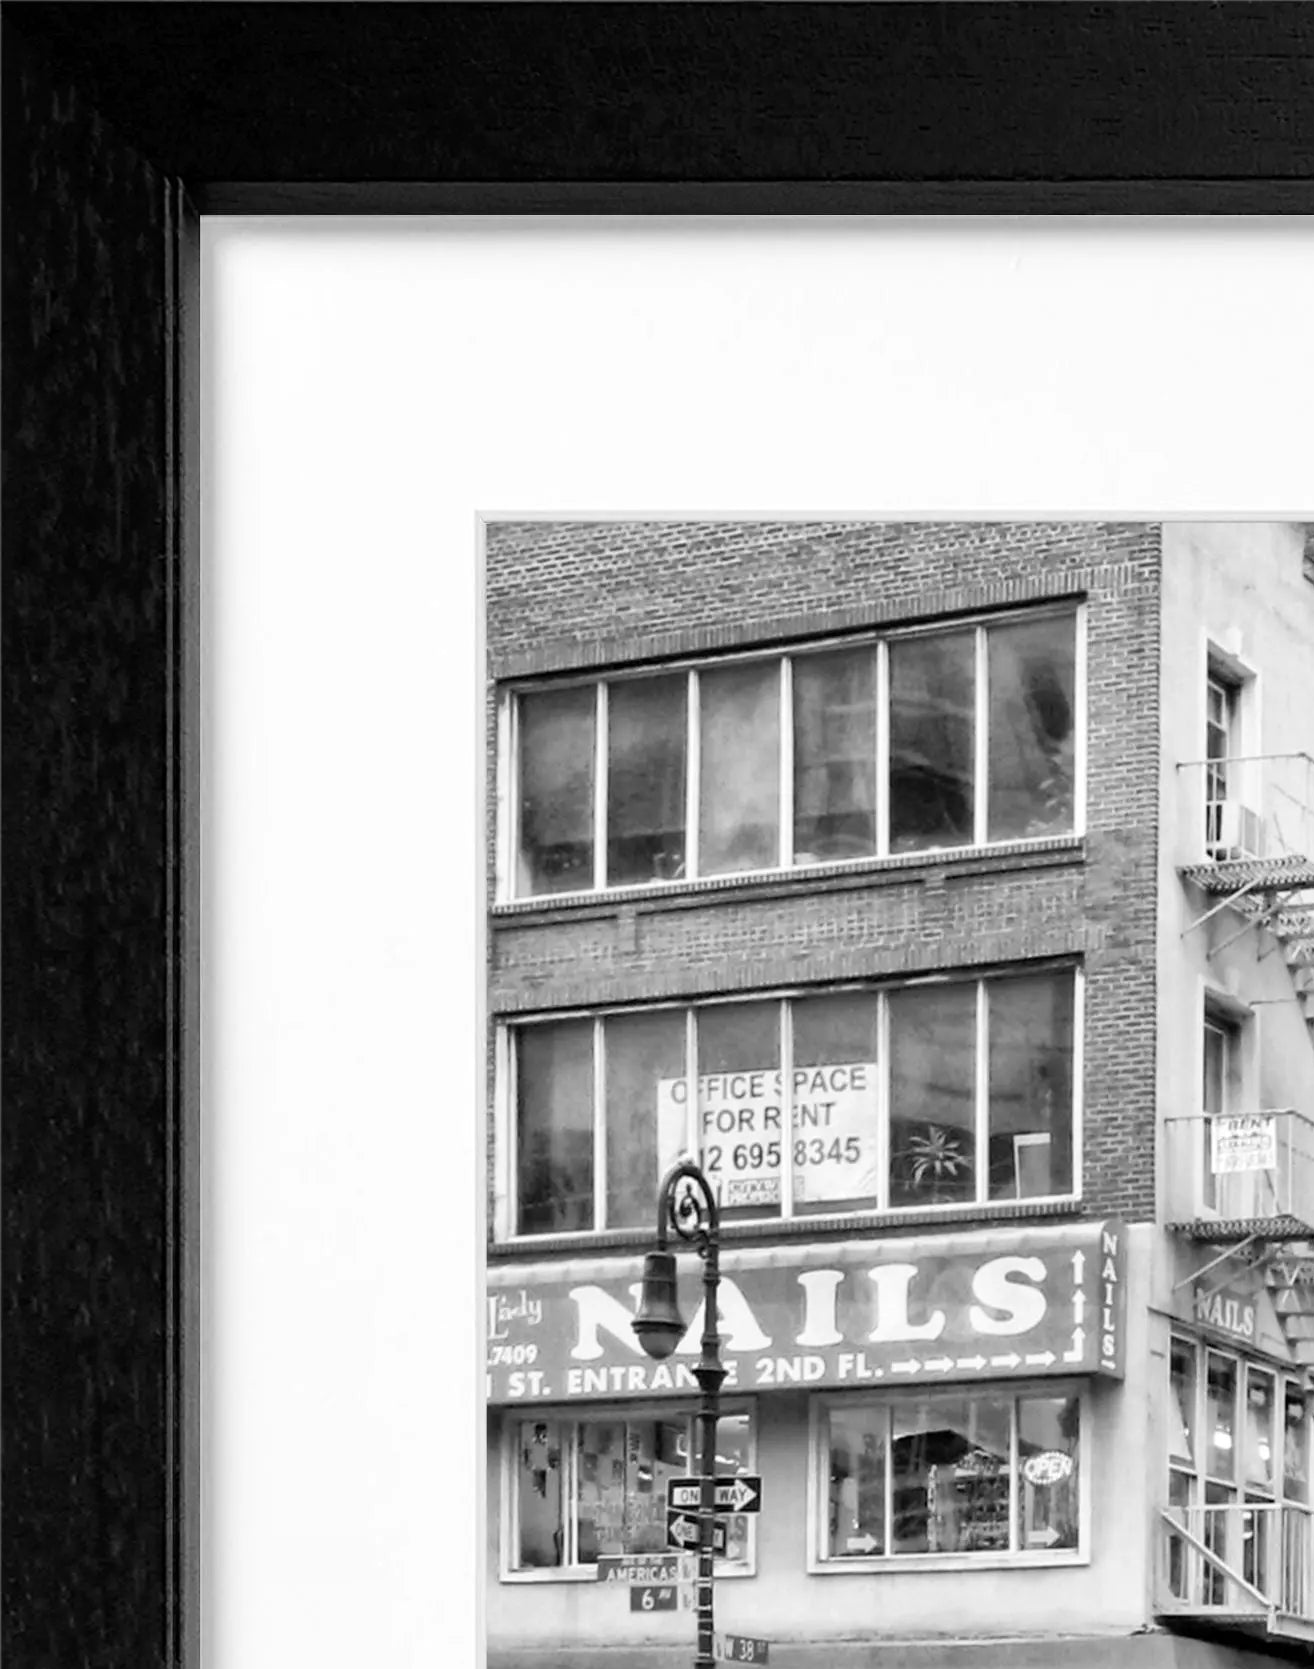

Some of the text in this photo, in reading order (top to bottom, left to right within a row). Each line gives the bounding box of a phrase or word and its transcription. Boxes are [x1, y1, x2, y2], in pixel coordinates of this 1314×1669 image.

[671, 1073, 764, 1104] OFICE
[703, 1108, 755, 1134] FOR
[733, 1142, 781, 1170] 695
[794, 1137, 860, 1166] 8345
[567, 1256, 1047, 1360] NAILS
[1102, 1232, 1118, 1357] NAILS
[1197, 1289, 1254, 1336] NAILS
[508, 1371, 551, 1397] ST.
[567, 1360, 738, 1395] ENTRANE
[755, 1356, 825, 1383] 2ND
[839, 1353, 884, 1380] FL.
[1028, 1453, 1072, 1481] OPEN
[719, 1488, 748, 1502] WAY
[606, 1566, 677, 1584] AMERICAS
[641, 1588, 655, 1610] 6
[739, 1639, 754, 1661] 38
